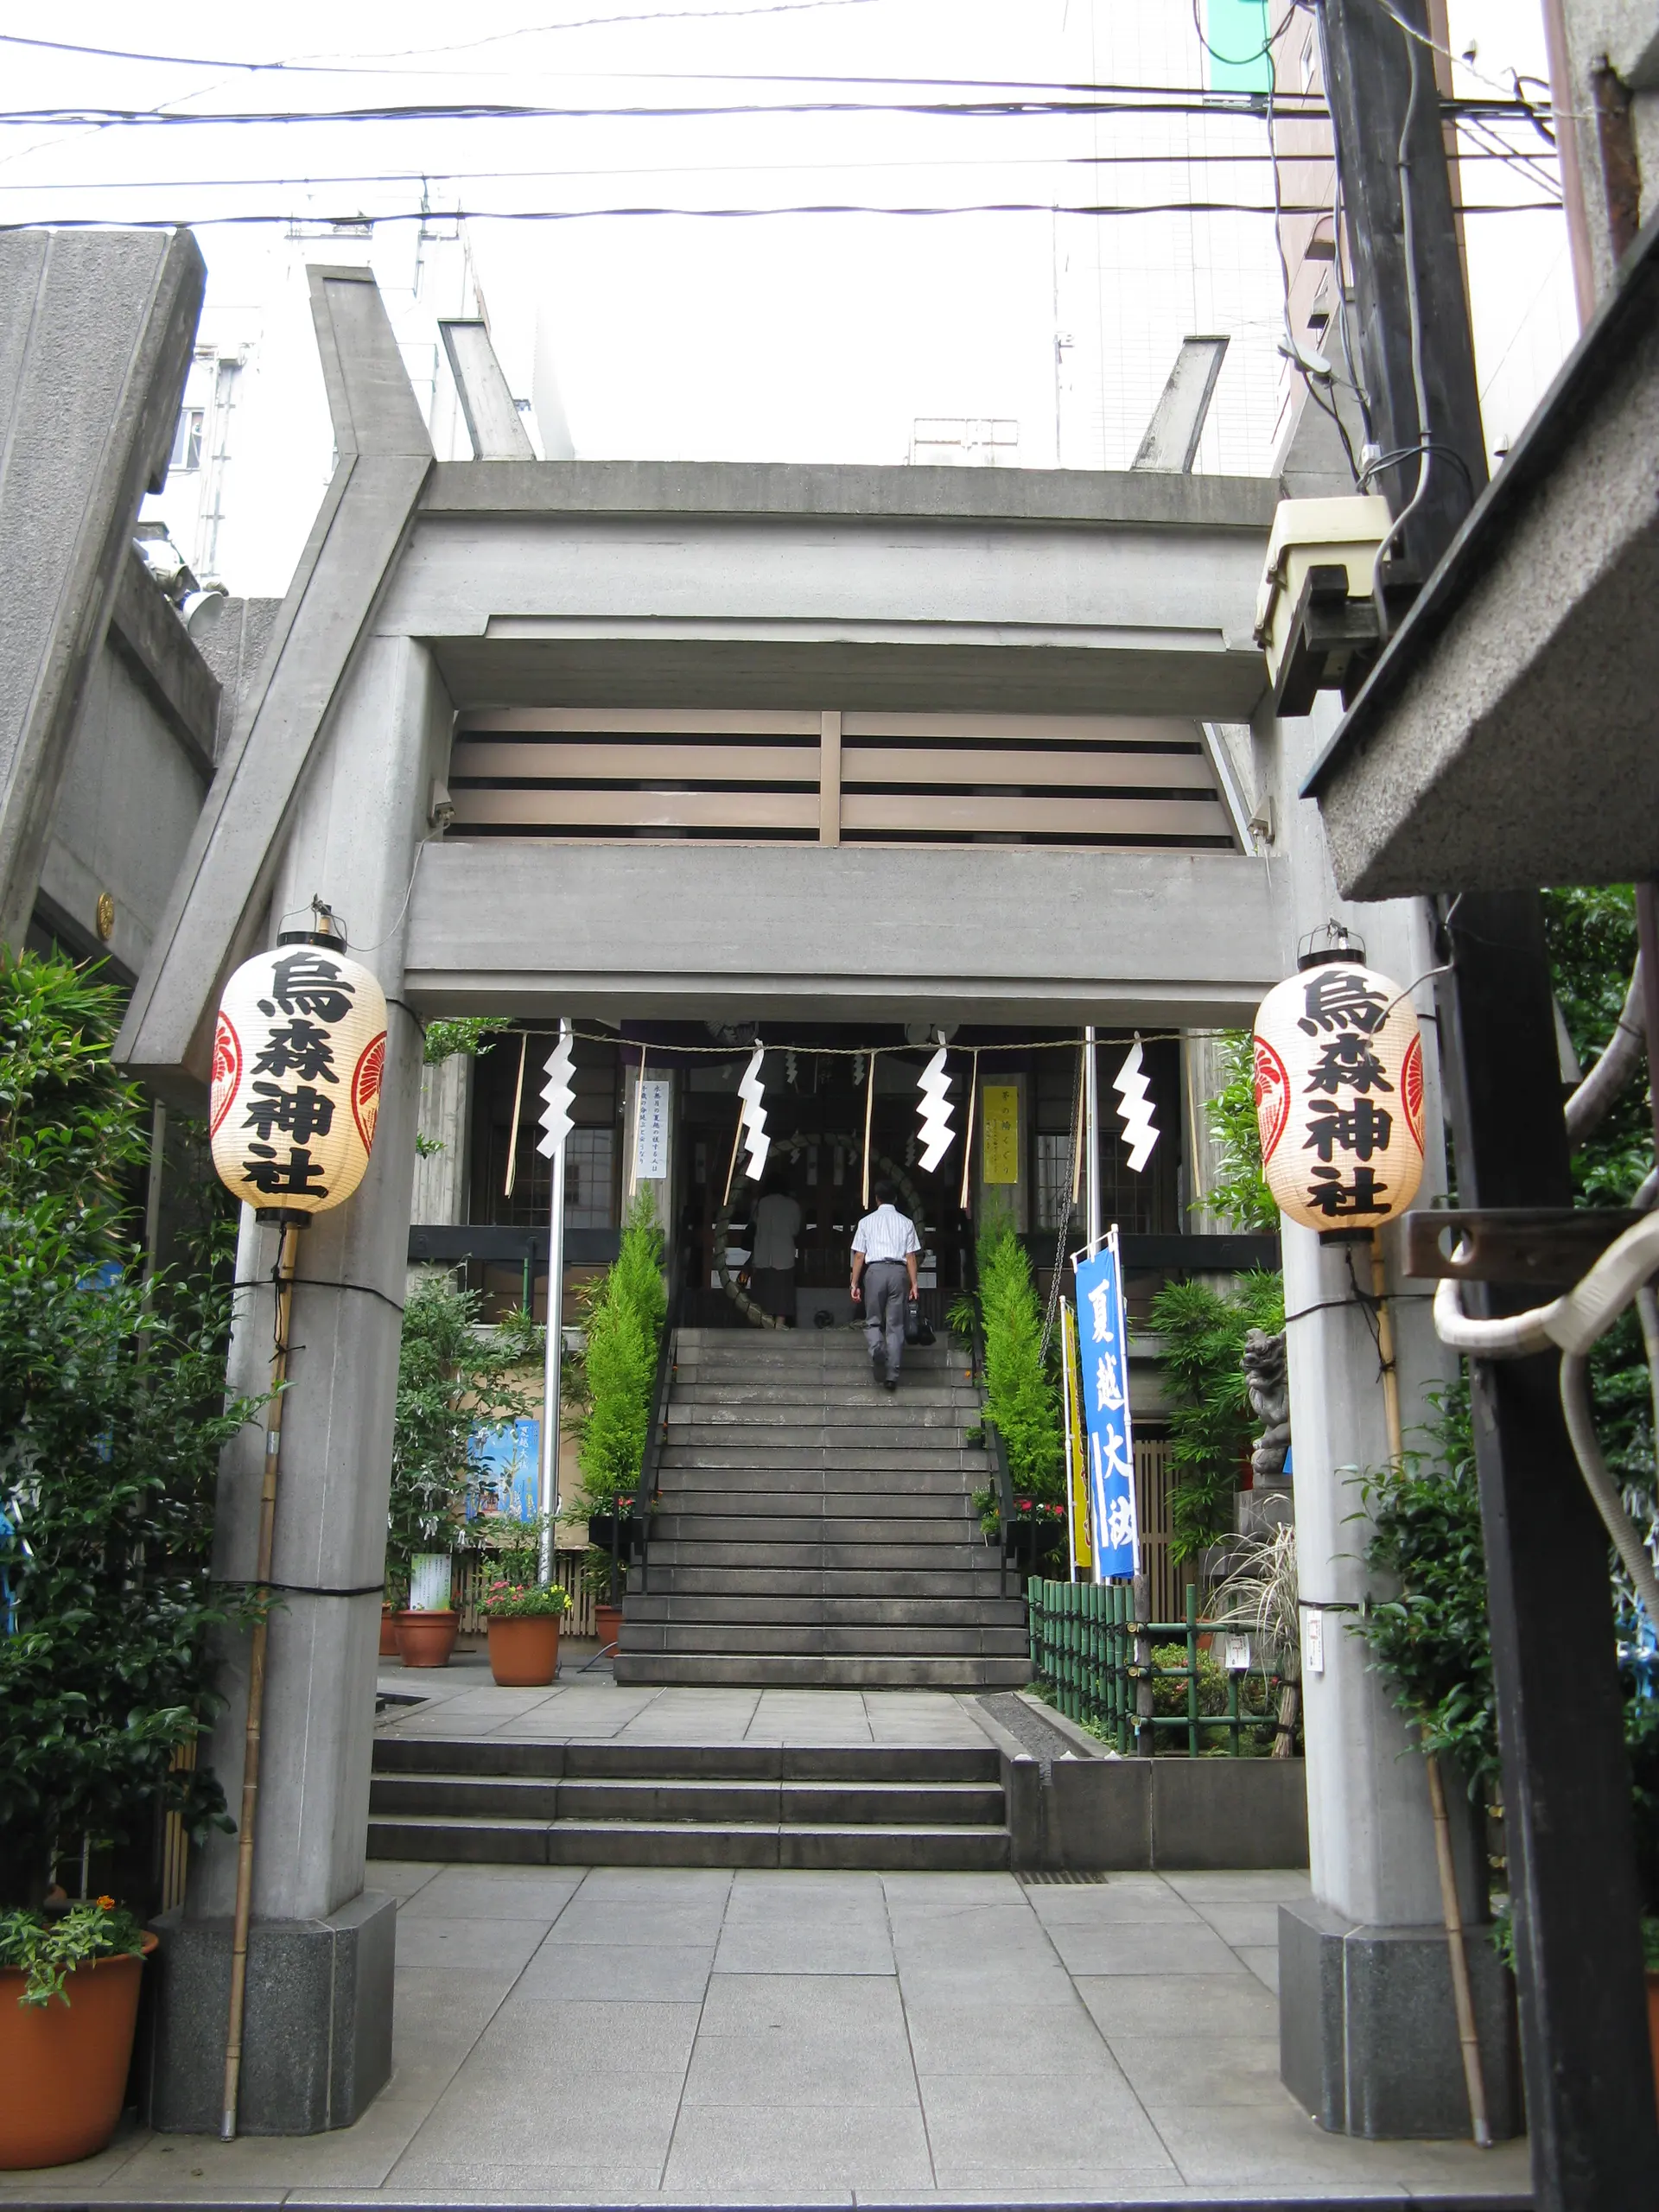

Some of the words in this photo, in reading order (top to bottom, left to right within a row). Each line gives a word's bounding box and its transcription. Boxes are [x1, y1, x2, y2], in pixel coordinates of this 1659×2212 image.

[240, 951, 356, 1198] 烏森神社
[1297, 970, 1395, 1217] 烏森神社
[1088, 1278, 1133, 1550] 夏越大祓
